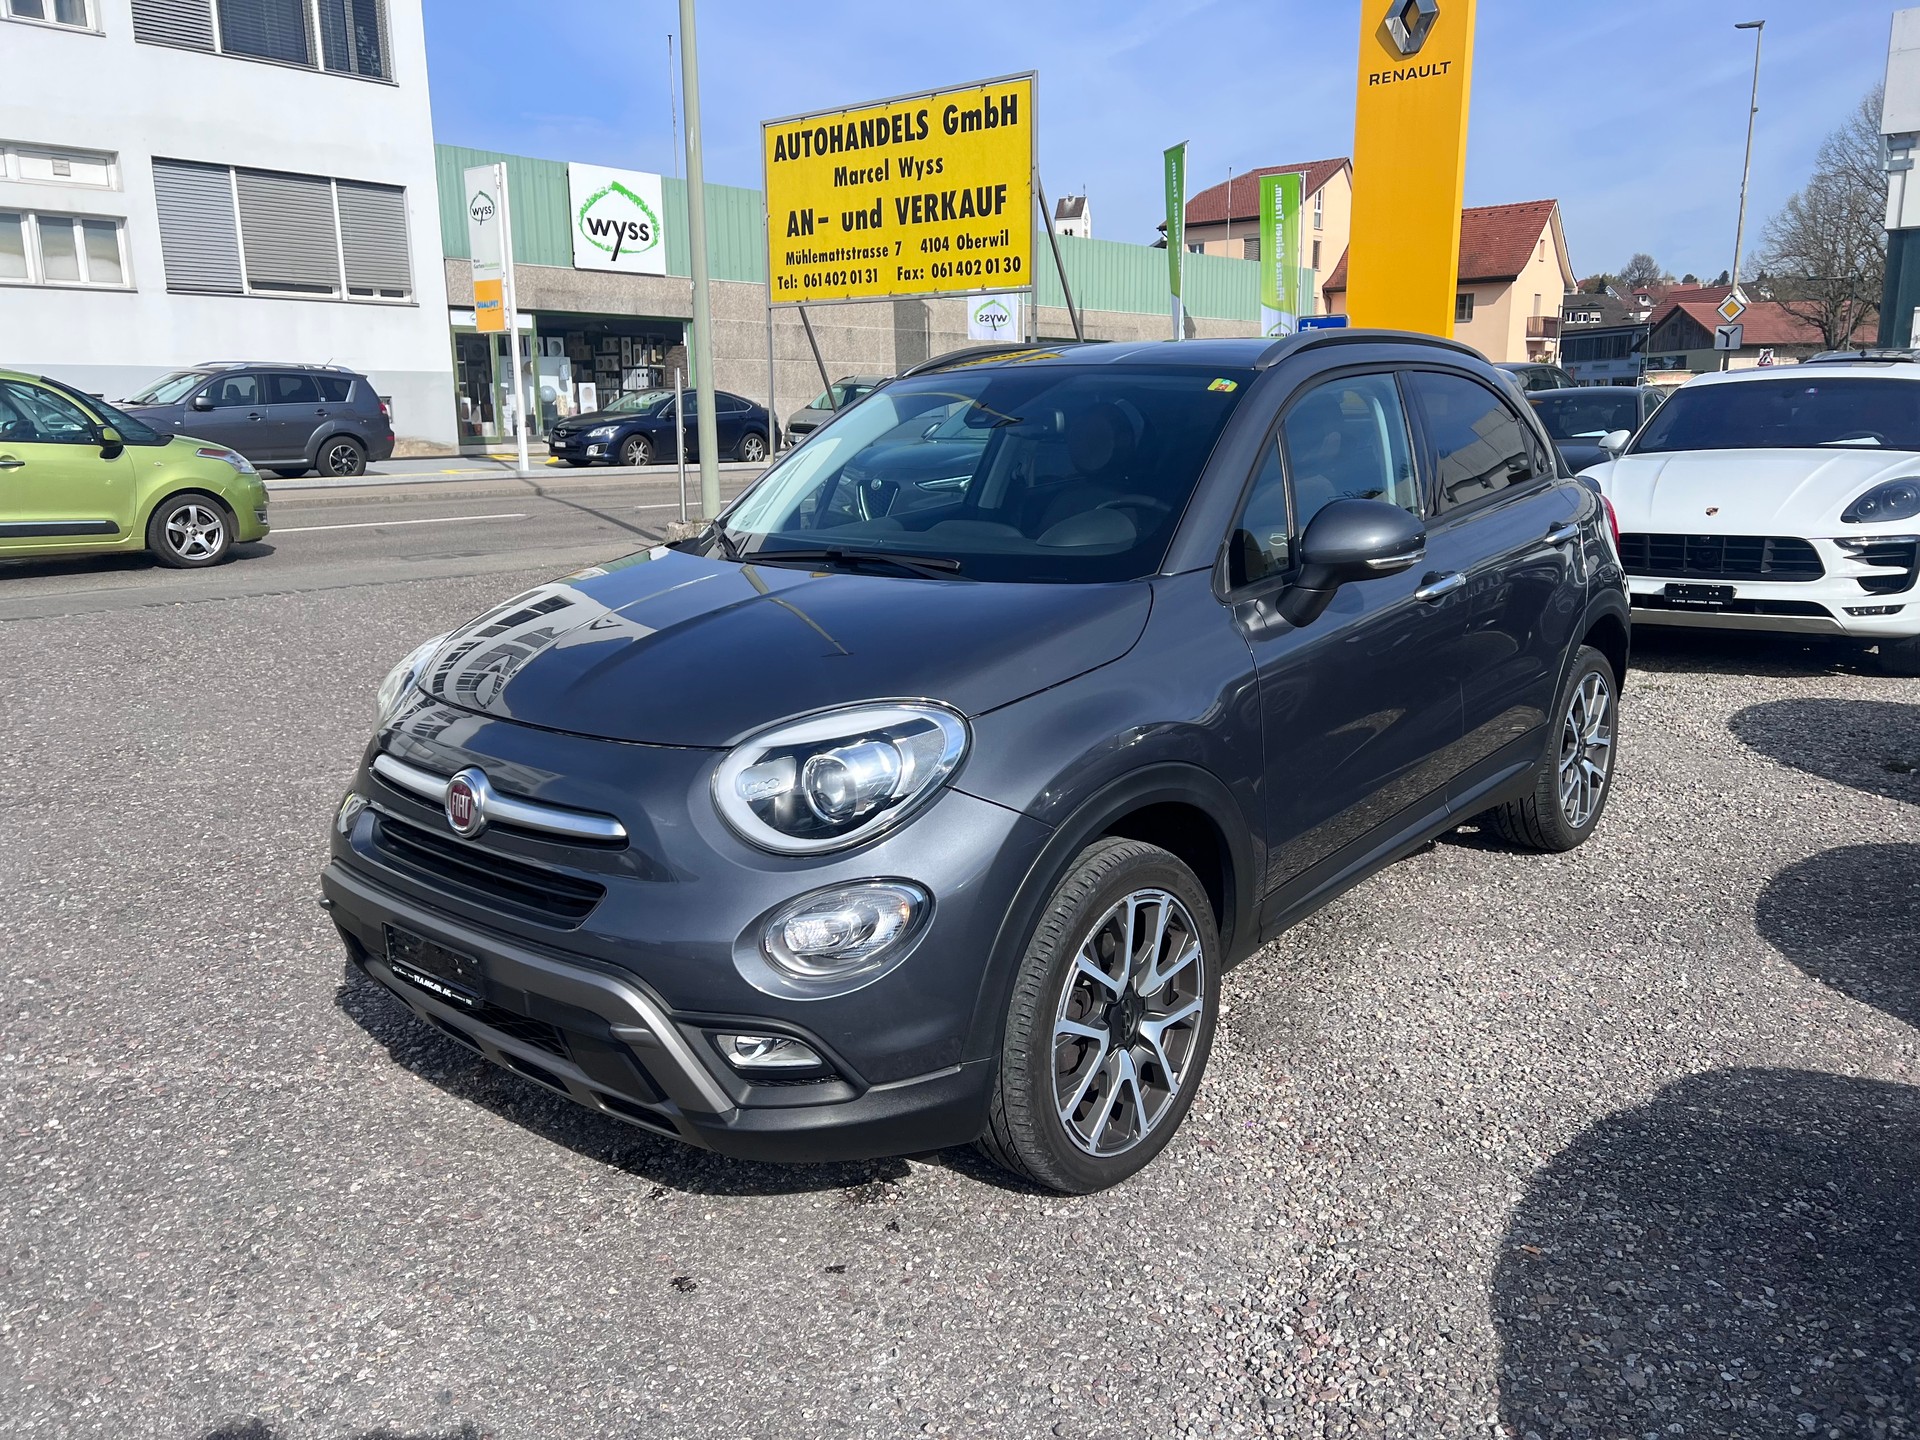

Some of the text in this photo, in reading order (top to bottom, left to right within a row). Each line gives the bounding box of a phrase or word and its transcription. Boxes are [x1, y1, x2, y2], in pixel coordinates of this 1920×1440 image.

[1369, 61, 1451, 86] RENAULT
[773, 93, 1018, 162] AUTOHANDELS GmbH
[834, 155, 944, 187] Marcel Wyss
[471, 206, 492, 226] wyss
[786, 183, 1007, 237] AN- und VERKAUF
[586, 217, 649, 261] wyss
[786, 229, 1009, 266] Mühlemattstrasse 7 4104 Oberwil
[777, 274, 798, 290] Tel:
[897, 266, 924, 281] Fax:
[452, 792, 471, 820] FIAT
